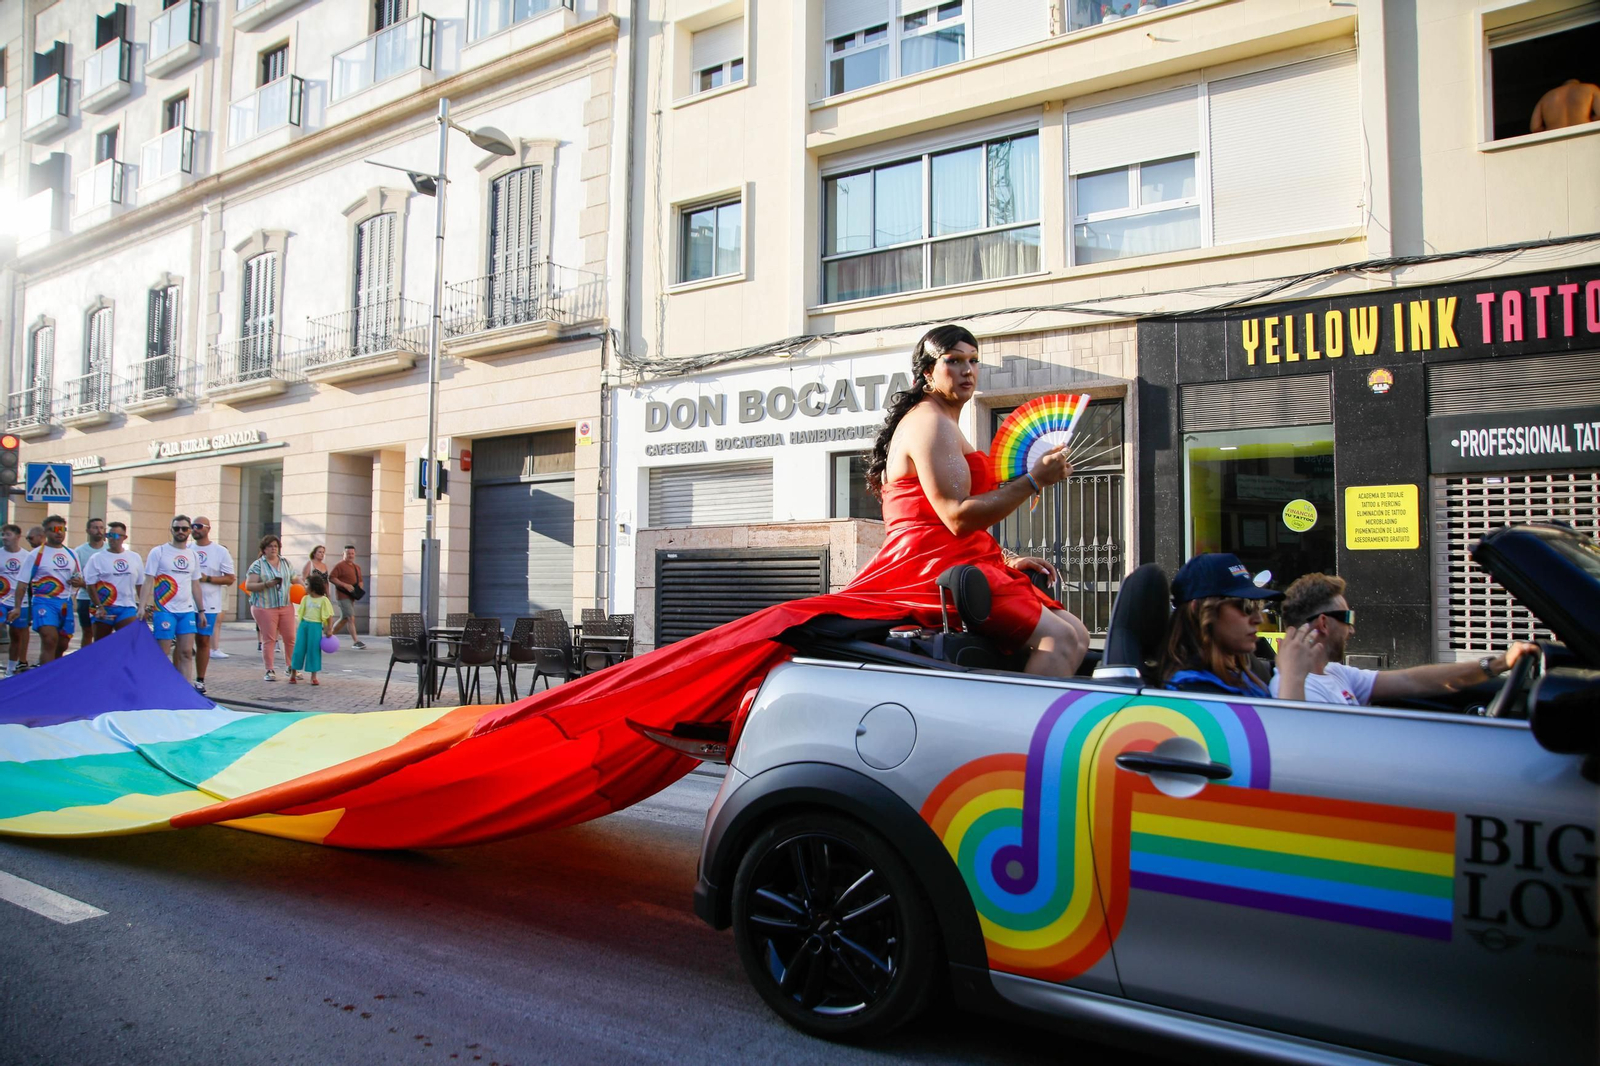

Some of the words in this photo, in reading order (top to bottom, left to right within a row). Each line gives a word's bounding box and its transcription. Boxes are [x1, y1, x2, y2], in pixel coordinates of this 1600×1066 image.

[1242, 306, 1379, 365] YELLOW
[1393, 297, 1459, 352] INK
[1476, 279, 1600, 344] TATTO
[645, 393, 727, 433] DON
[738, 372, 911, 424] BOCATA
[180, 436, 211, 453] RURAL
[211, 429, 260, 449] GRANADA
[645, 440, 708, 457] CAFETERIA
[715, 433, 785, 451] BOCATERIA
[1460, 424, 1572, 458] PROFESSIONAL
[1574, 421, 1600, 451] TAT
[1286, 508, 1314, 518] FINANCIA
[1293, 514, 1314, 522] TATTOO
[1464, 814, 1599, 878] BIG
[1462, 871, 1600, 938] LOV
